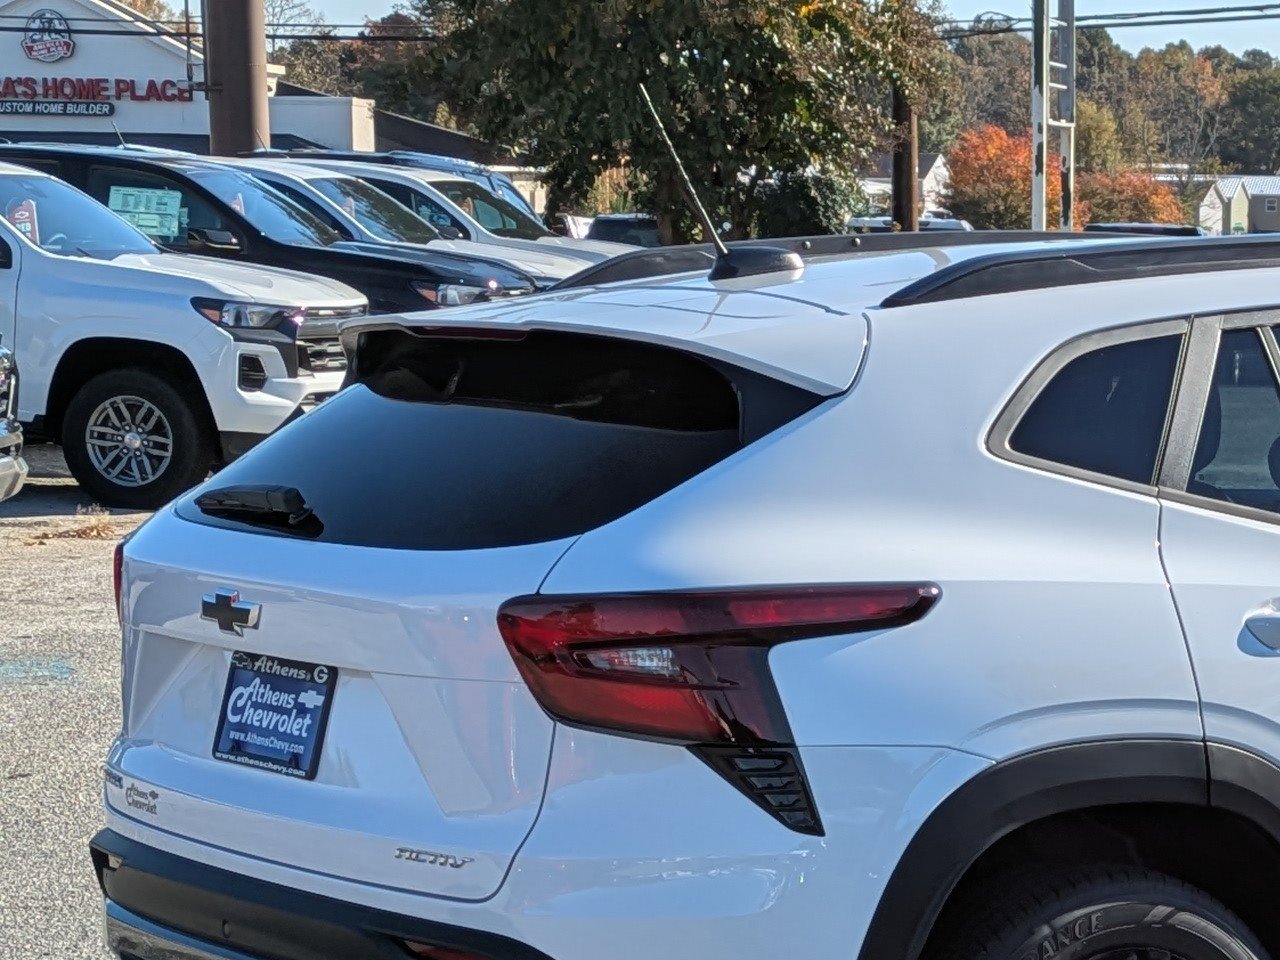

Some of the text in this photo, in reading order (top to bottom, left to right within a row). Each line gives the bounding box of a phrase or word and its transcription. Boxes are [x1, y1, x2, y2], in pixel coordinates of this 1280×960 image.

[0, 76, 193, 102] A'S HOME PLACE
[35, 103, 64, 114] HOME
[66, 104, 110, 115] BUILDER
[242, 676, 296, 709] Athens
[226, 685, 312, 738] Chevrolet
[228, 730, 305, 755] www.AthensChevy.com
[214, 751, 306, 777] www.athenschevy.com
